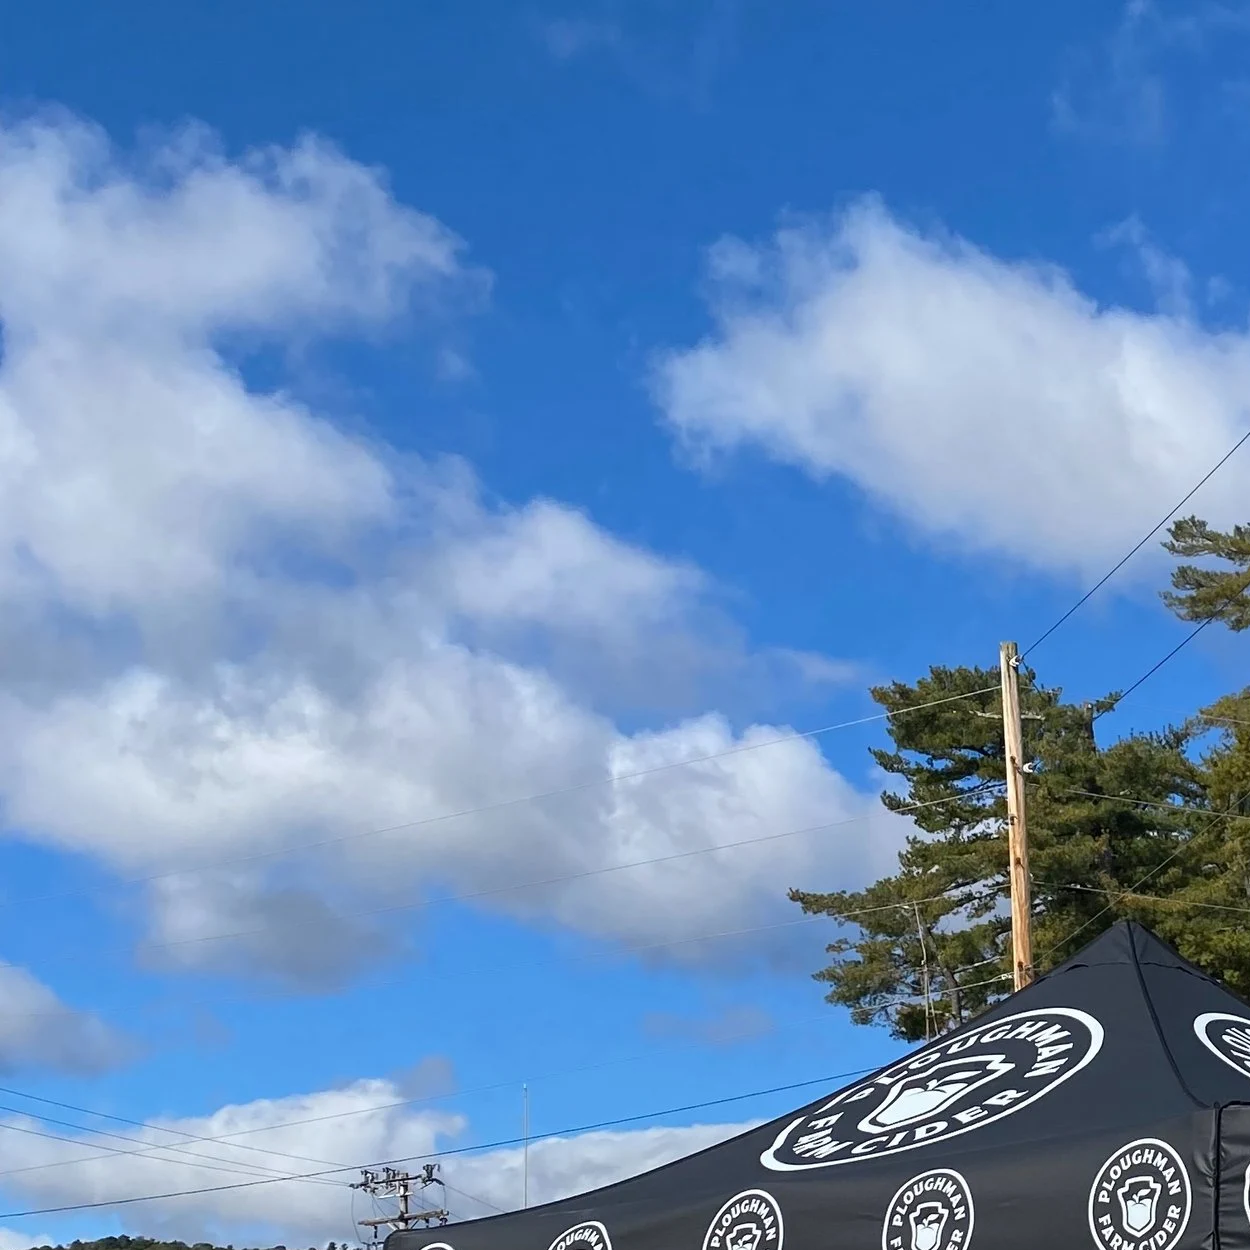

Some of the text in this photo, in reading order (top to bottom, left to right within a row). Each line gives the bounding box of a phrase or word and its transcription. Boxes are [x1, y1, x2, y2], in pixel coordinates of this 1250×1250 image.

[892, 1176, 966, 1227] PLOUGHMAN
[1098, 1148, 1182, 1204] PLOUGHMAN
[710, 1198, 776, 1249] PLOUGHMAN
